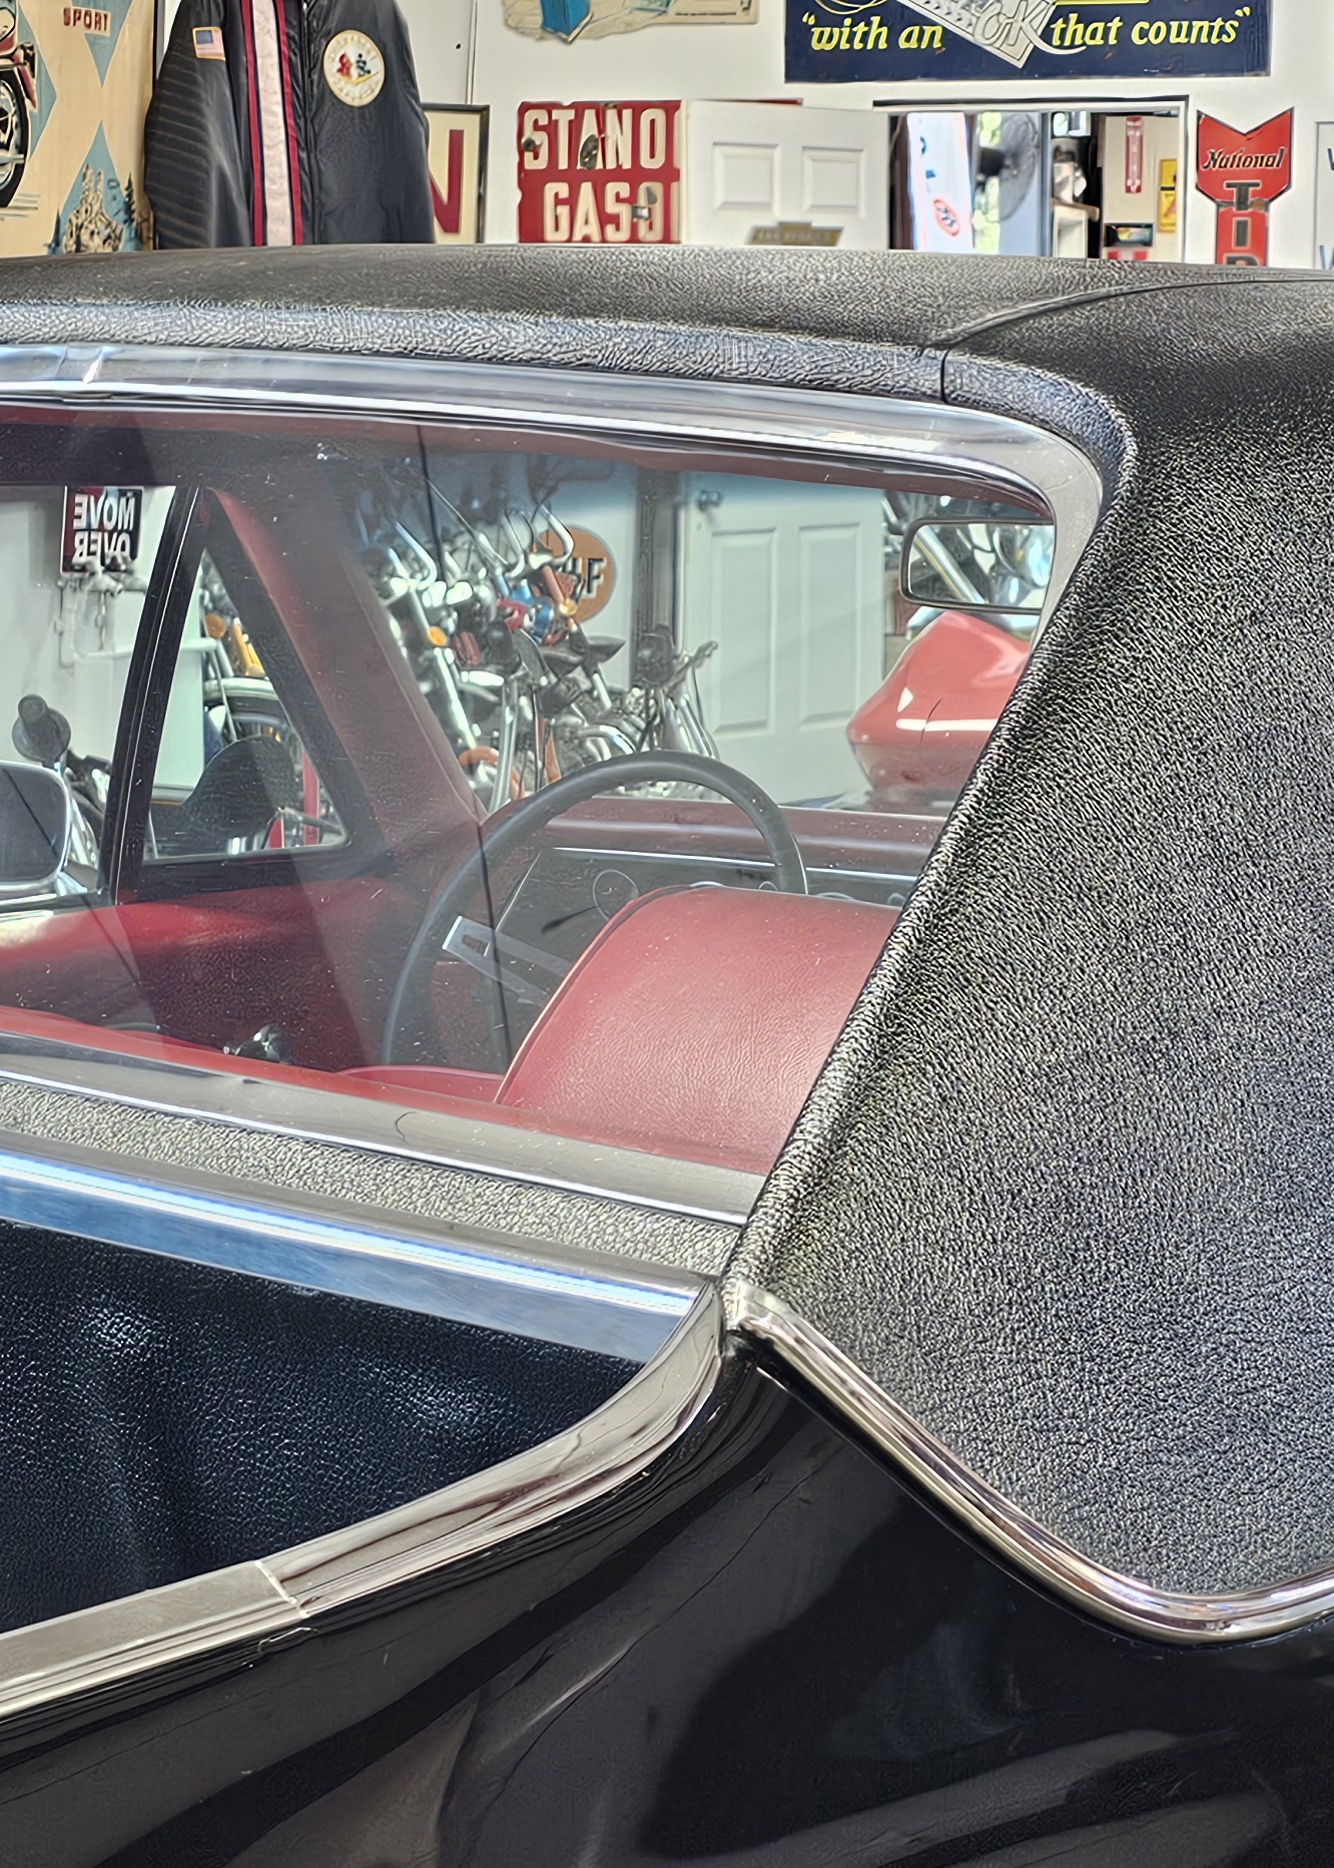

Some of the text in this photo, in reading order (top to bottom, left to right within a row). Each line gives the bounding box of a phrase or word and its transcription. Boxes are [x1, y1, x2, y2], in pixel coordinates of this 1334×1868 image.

[63, 7, 108, 31] SPORT
[898, 25, 943, 49] an
[1050, 13, 1123, 46] that
[521, 108, 679, 170] STANO
[1202, 146, 1286, 171] National
[543, 181, 679, 243] GASO
